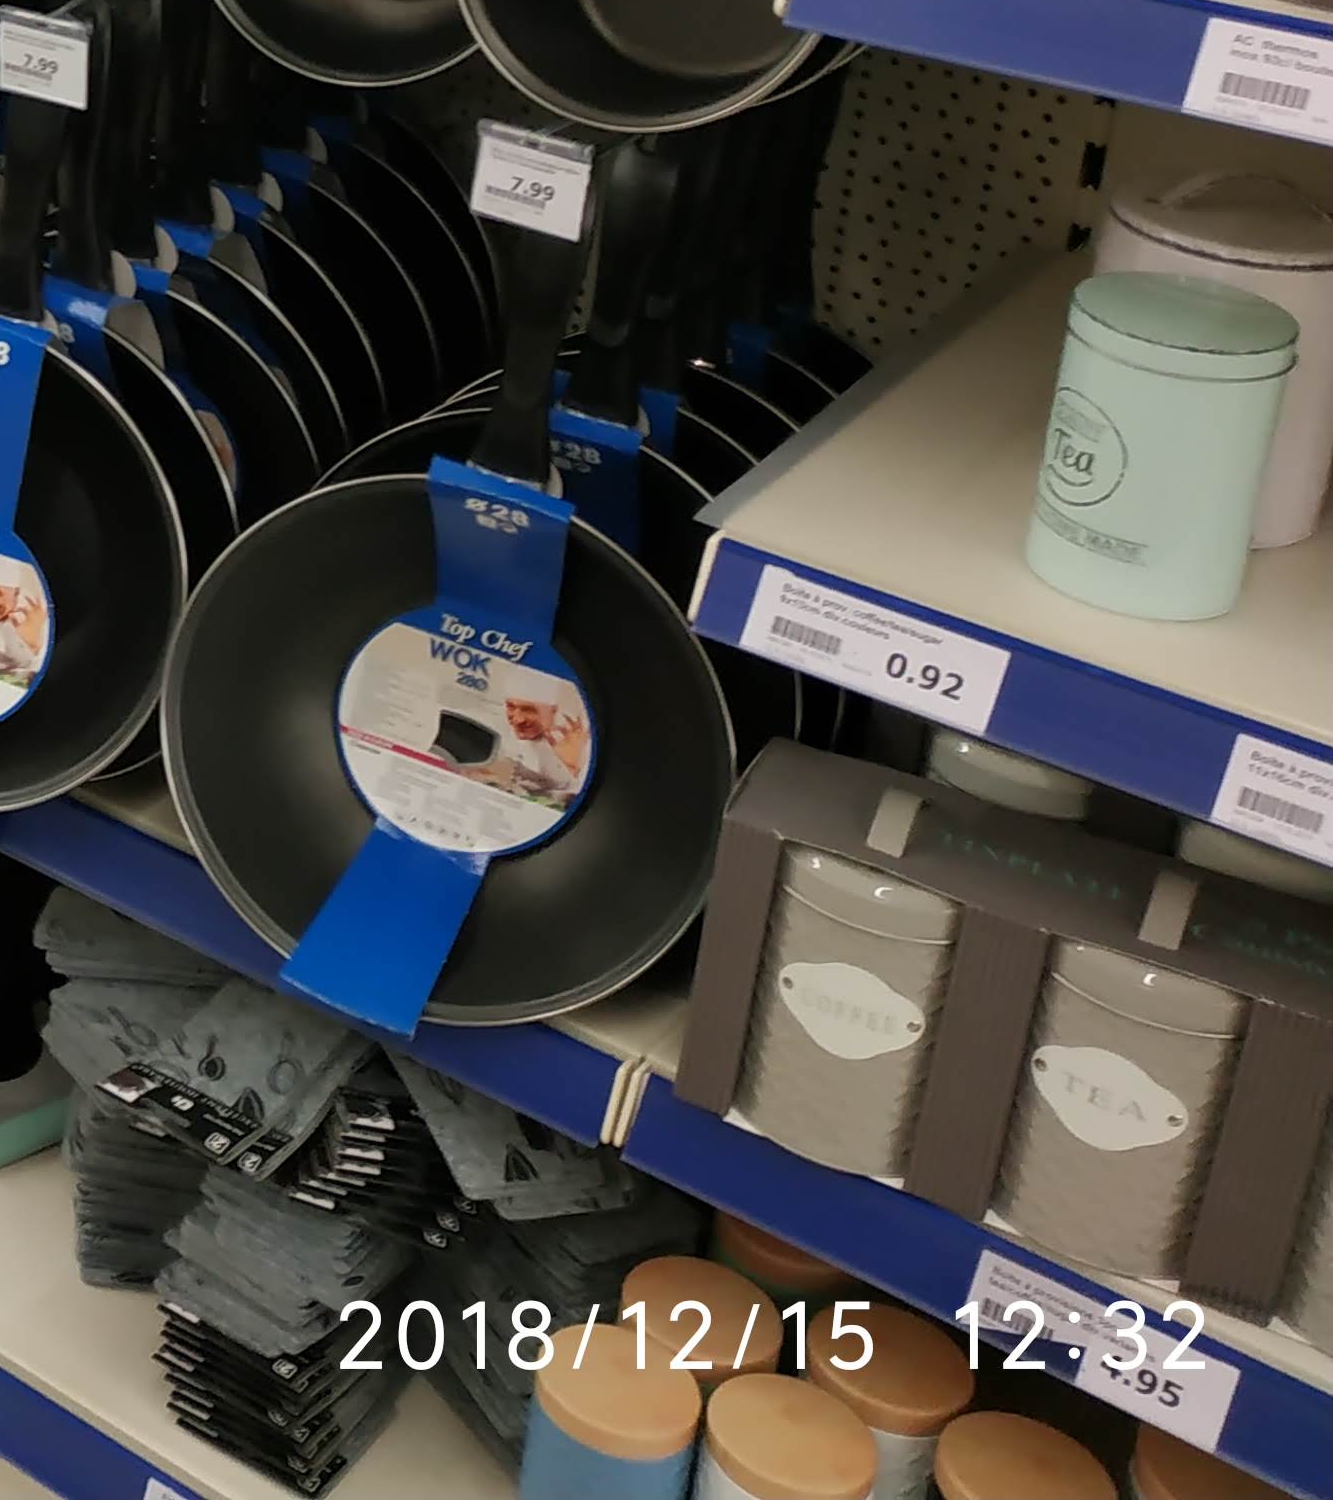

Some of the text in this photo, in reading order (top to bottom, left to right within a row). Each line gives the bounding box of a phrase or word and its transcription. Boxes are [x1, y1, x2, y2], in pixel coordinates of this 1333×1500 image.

[23, 52, 59, 76] 7.99
[511, 175, 556, 203] 7.99
[1051, 427, 1096, 476] Tea
[464, 497, 531, 529] Ø28
[429, 636, 493, 676] WOK
[438, 612, 534, 664] Top Chef
[885, 651, 965, 701] 0.92
[1061, 1069, 1148, 1123] TEA
[1099, 1355, 1185, 1410] 4.95
